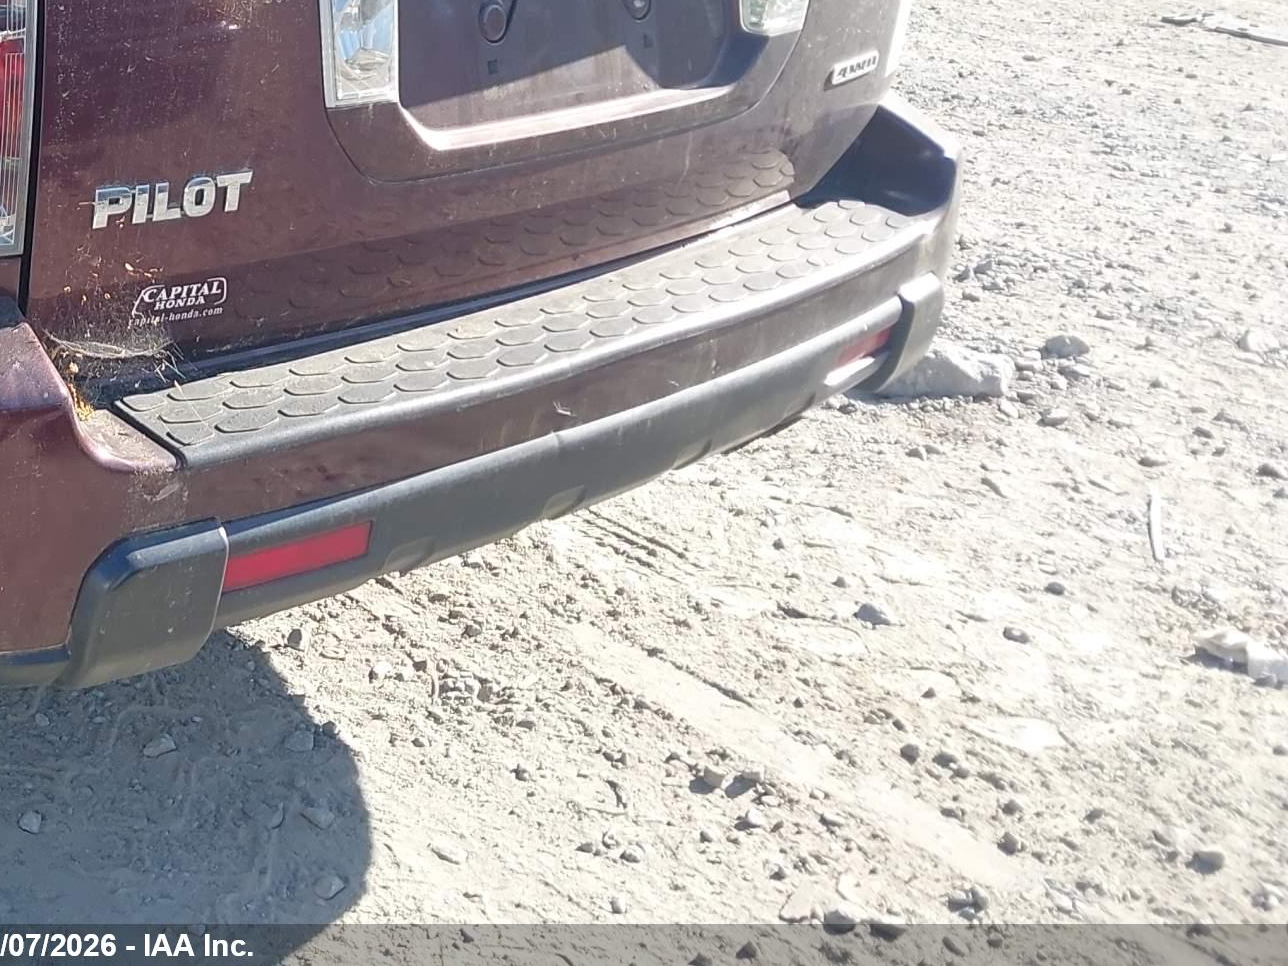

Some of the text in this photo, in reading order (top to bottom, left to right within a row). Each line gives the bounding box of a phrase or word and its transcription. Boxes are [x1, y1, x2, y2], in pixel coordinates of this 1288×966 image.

[92, 169, 254, 230] PILOT
[142, 281, 222, 303] CAPITAL
[154, 296, 206, 311] HONDA
